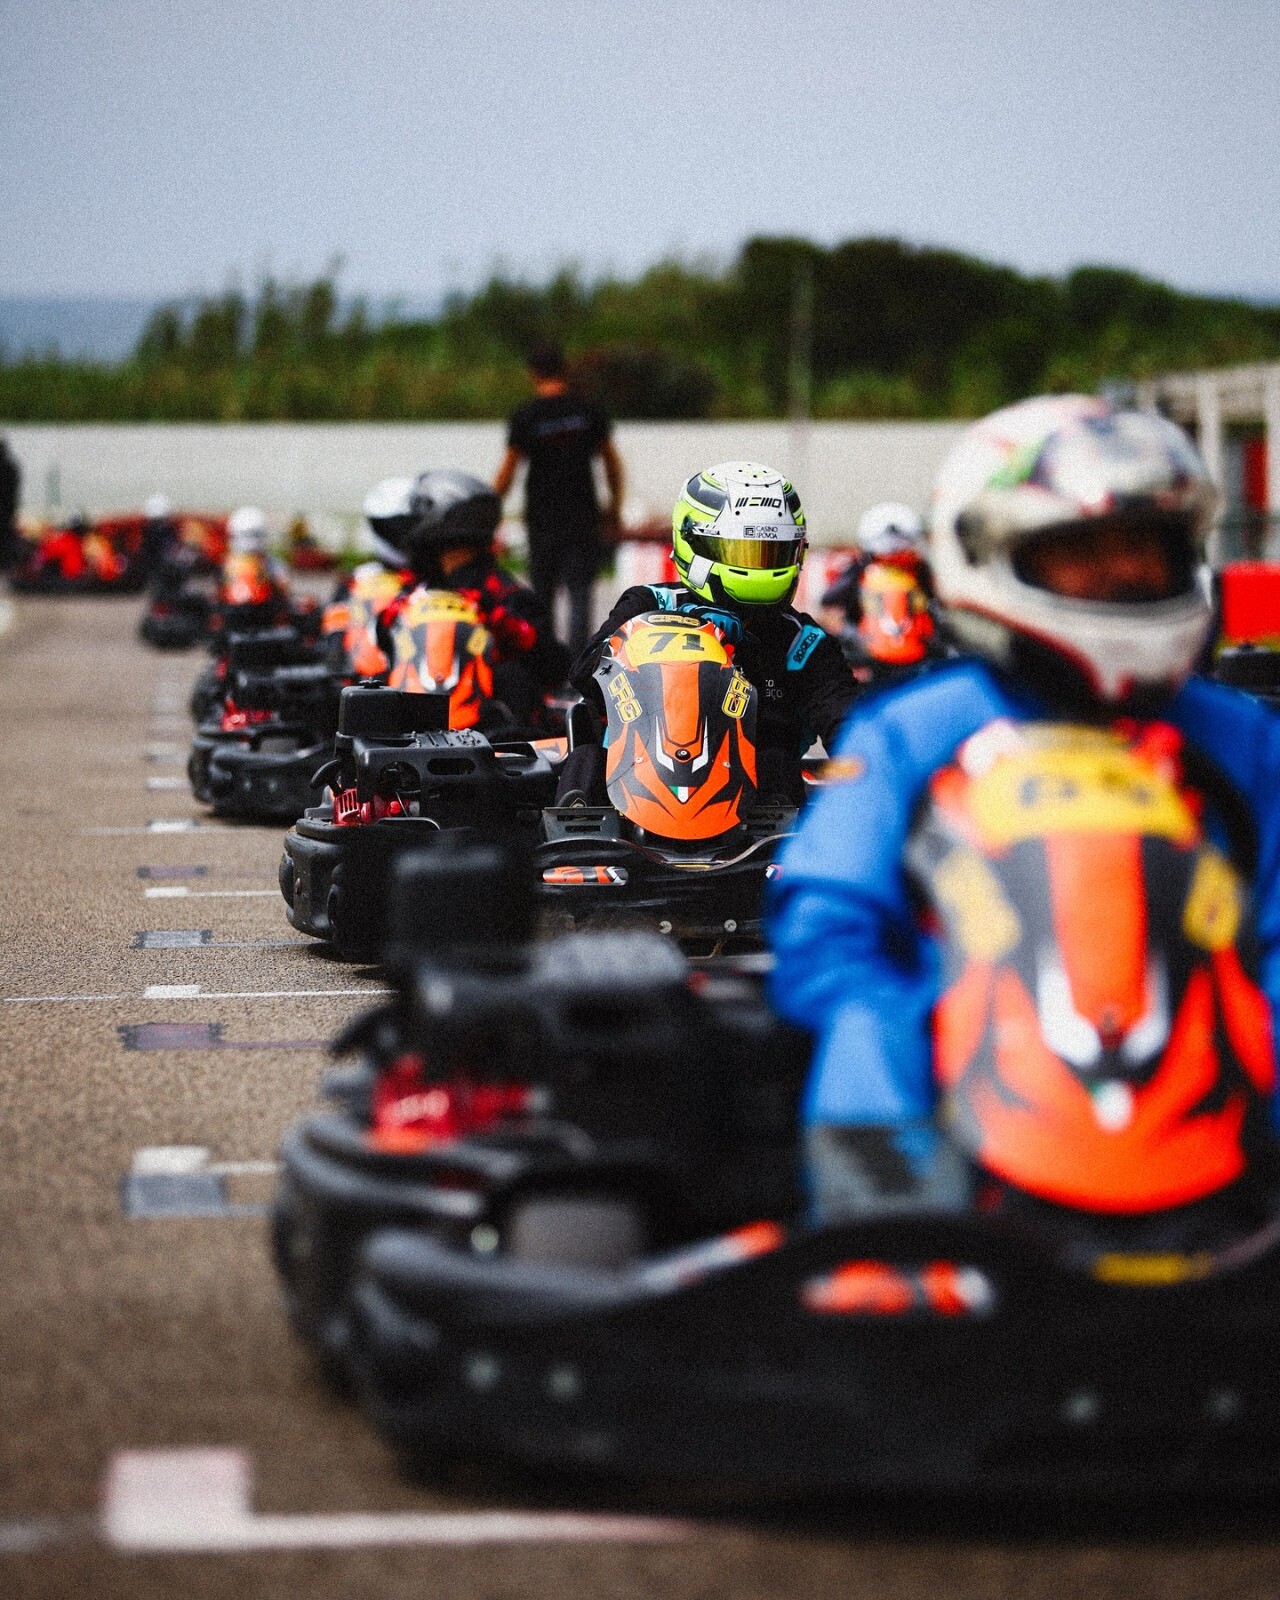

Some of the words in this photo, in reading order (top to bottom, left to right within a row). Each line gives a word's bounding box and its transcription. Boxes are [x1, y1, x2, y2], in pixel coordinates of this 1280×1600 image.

[756, 526, 778, 534] CASINO
[649, 632, 705, 655] 71
[792, 632, 819, 664] sparco
[607, 670, 643, 724] CRG
